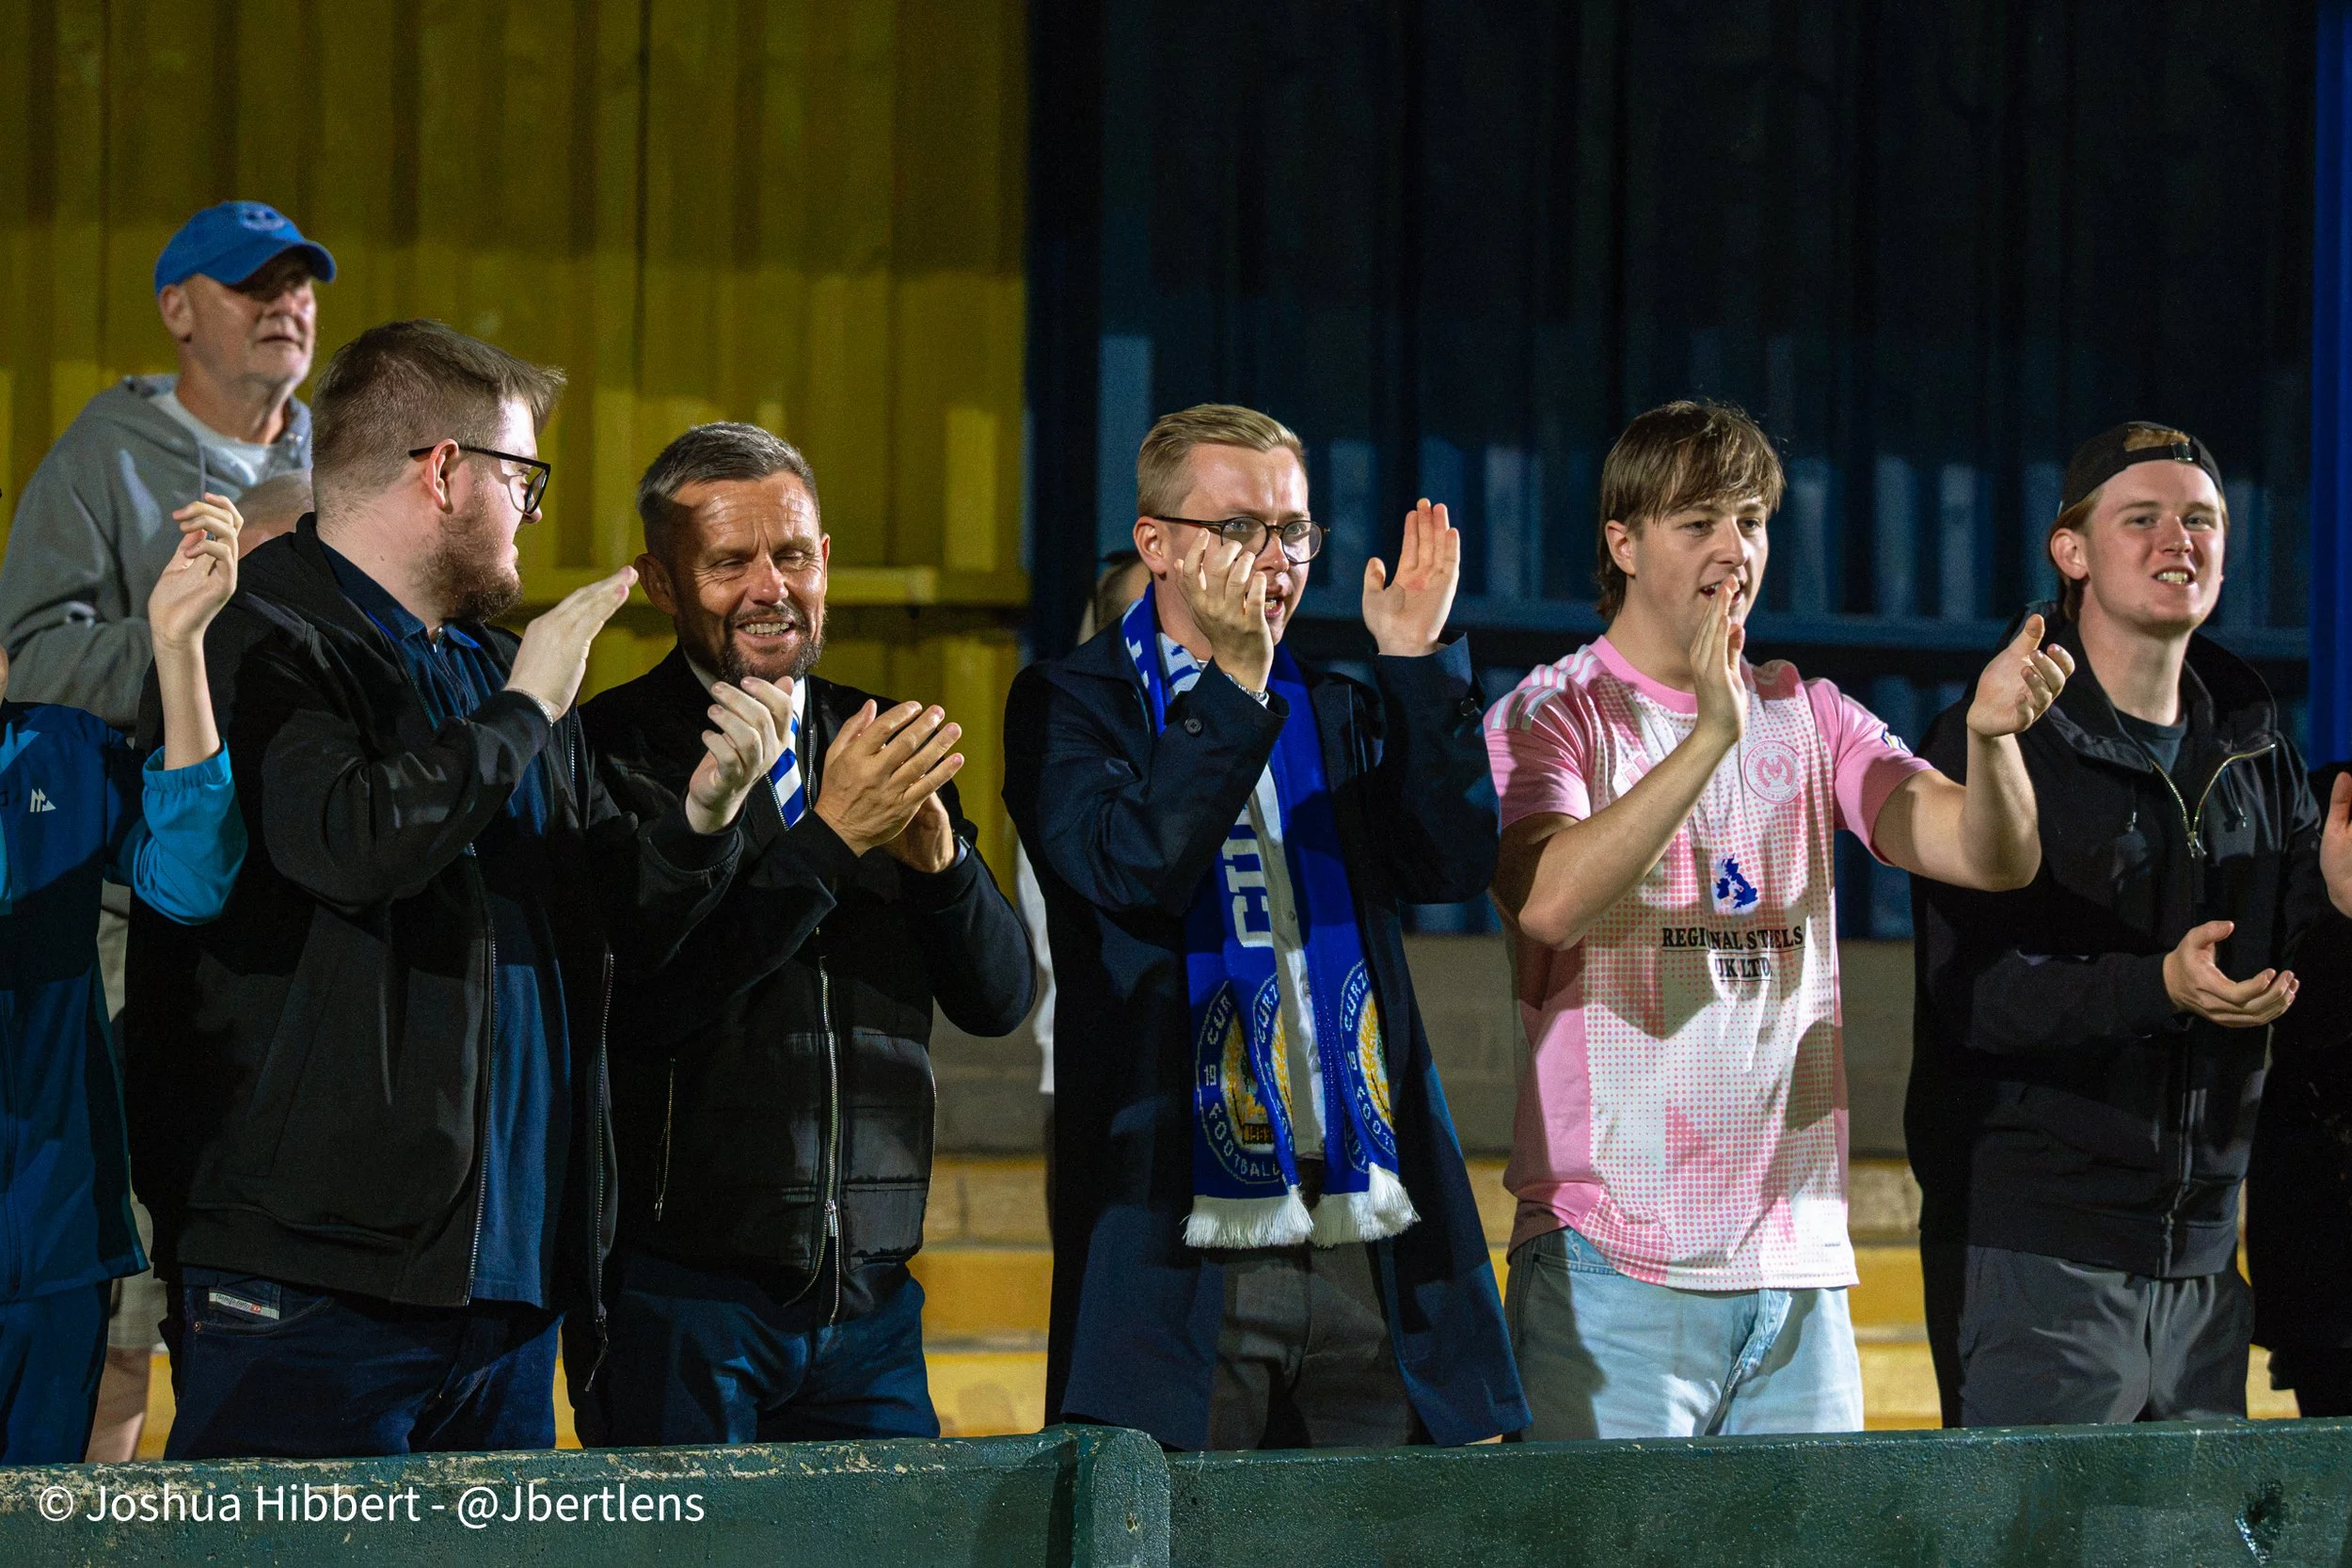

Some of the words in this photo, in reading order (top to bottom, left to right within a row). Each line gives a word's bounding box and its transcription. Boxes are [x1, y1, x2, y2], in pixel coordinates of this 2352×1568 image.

[1258, 985, 1279, 1043] CURZ
[1344, 970, 1368, 1031] CURZ
[1204, 1063, 1217, 1086] 19
